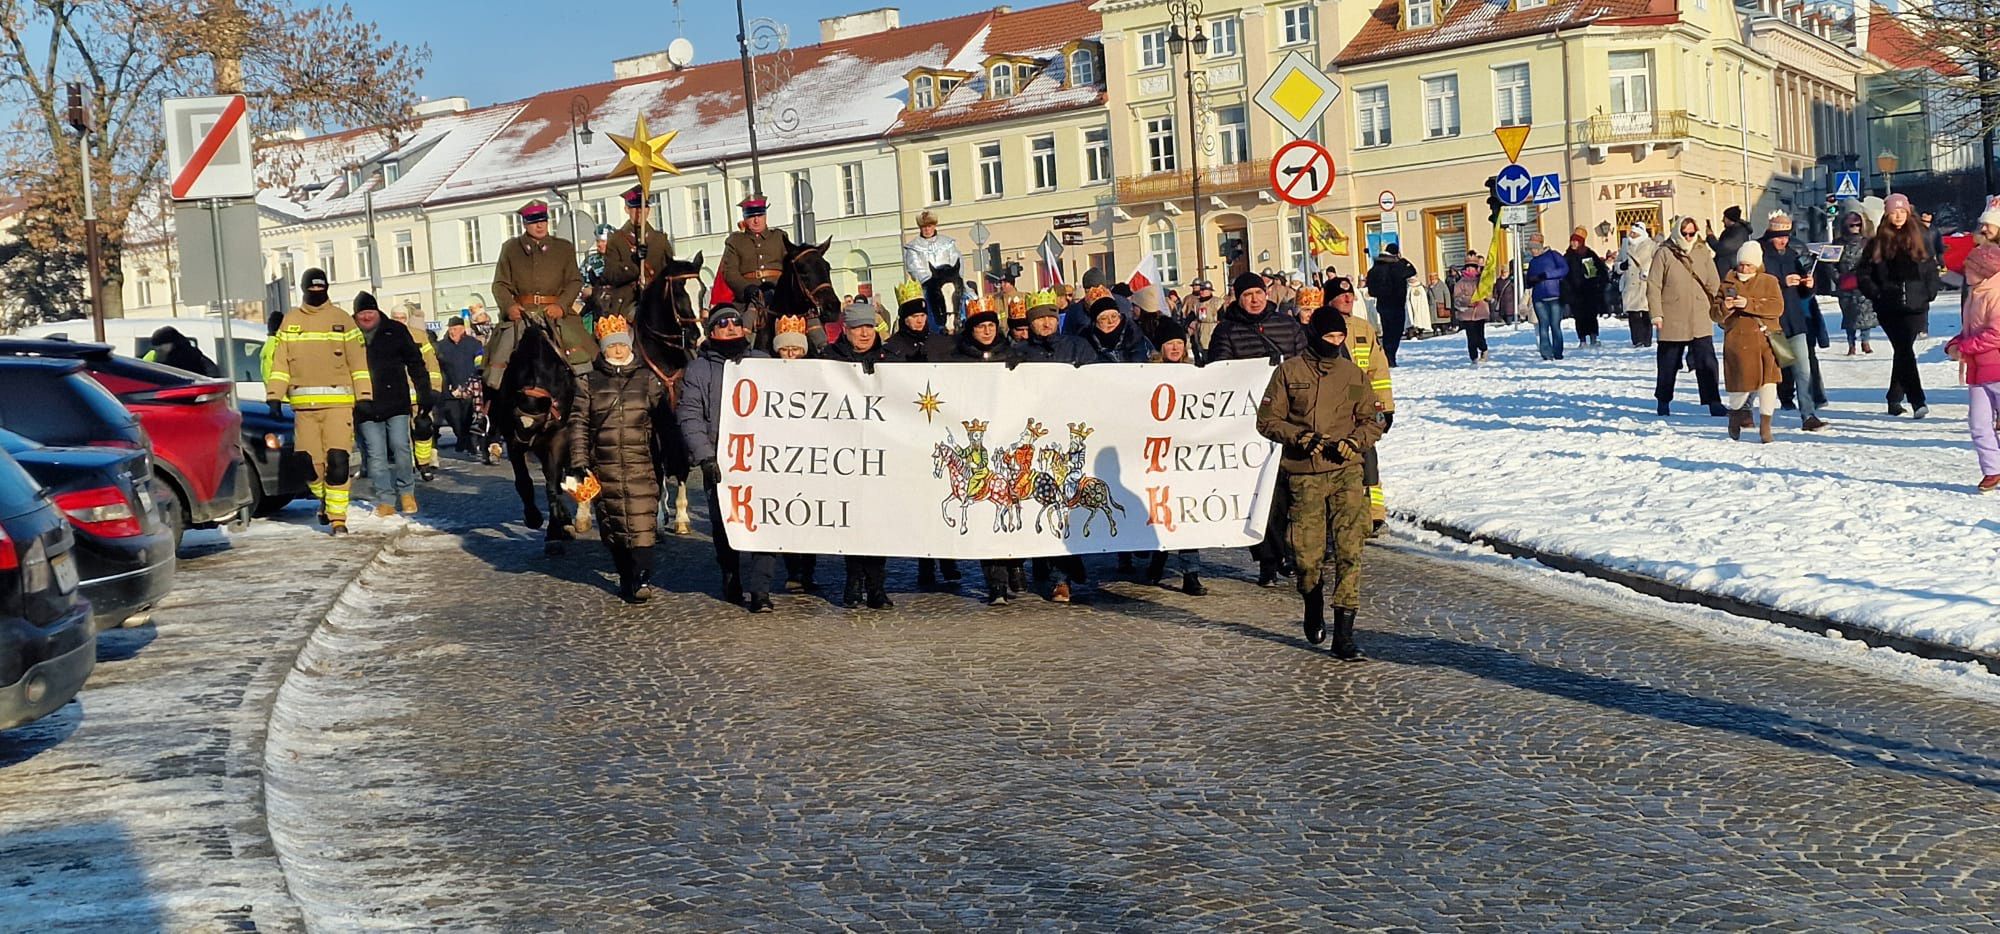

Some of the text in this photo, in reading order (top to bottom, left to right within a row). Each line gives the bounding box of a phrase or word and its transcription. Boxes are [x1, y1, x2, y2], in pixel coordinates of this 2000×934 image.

[732, 378, 887, 422] ORSZAK
[1150, 383, 1259, 422] ORSZA
[727, 433, 887, 477] TRZECH
[1143, 437, 1274, 475] TRZEC
[727, 485, 851, 532] KRÓLI
[1145, 485, 1258, 532] KRÓL
